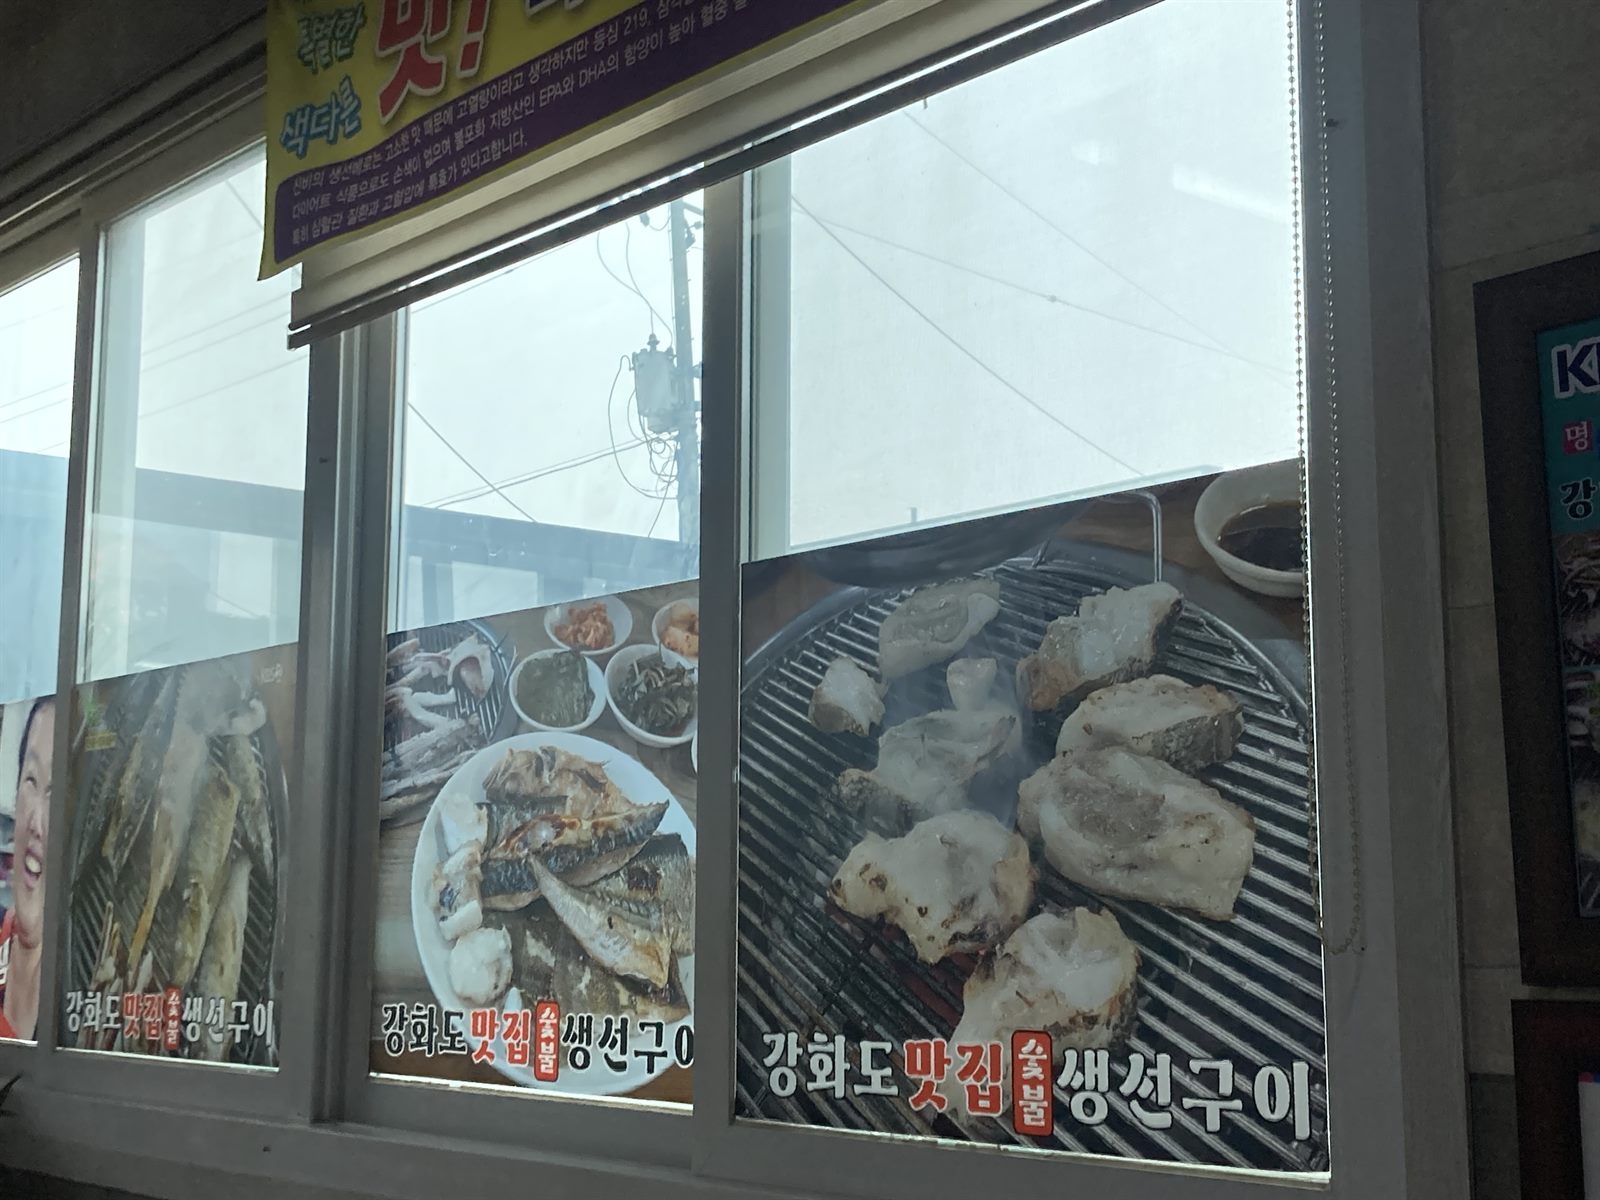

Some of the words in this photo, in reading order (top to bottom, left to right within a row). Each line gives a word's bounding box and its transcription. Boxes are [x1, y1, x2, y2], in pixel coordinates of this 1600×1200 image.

[280, 73, 362, 159] 색다른
[293, 192, 332, 219] 다이어트
[336, 172, 390, 204] 식품으로도
[393, 152, 421, 185] 손색이
[454, 117, 486, 151] 불포화
[490, 90, 535, 130] 지방산인
[540, 73, 574, 107] EPA와
[579, 51, 619, 88] DHA의
[668, 13, 695, 45] 높아
[411, 125, 420, 147] 맛
[423, 104, 453, 137] 때문에
[528, 36, 588, 84] 생각하지만
[347, 199, 379, 226] 질환과
[382, 179, 425, 212] 고혈압에
[428, 161, 458, 190] 특효가
[1552, 336, 1600, 399] K
[66, 990, 122, 1032] 강화도
[123, 992, 163, 1040] 맛집
[166, 991, 181, 1045] 숯불
[182, 997, 274, 1046] 생선구이
[382, 1002, 467, 1057] 강화도
[469, 1007, 532, 1066] 맛집
[538, 1005, 558, 1075] 숯불
[762, 1031, 899, 1099] 강화도
[902, 1038, 1004, 1117] 맛집
[1017, 1037, 1049, 1128] 숯불
[1055, 1047, 1312, 1141] 생선구이
